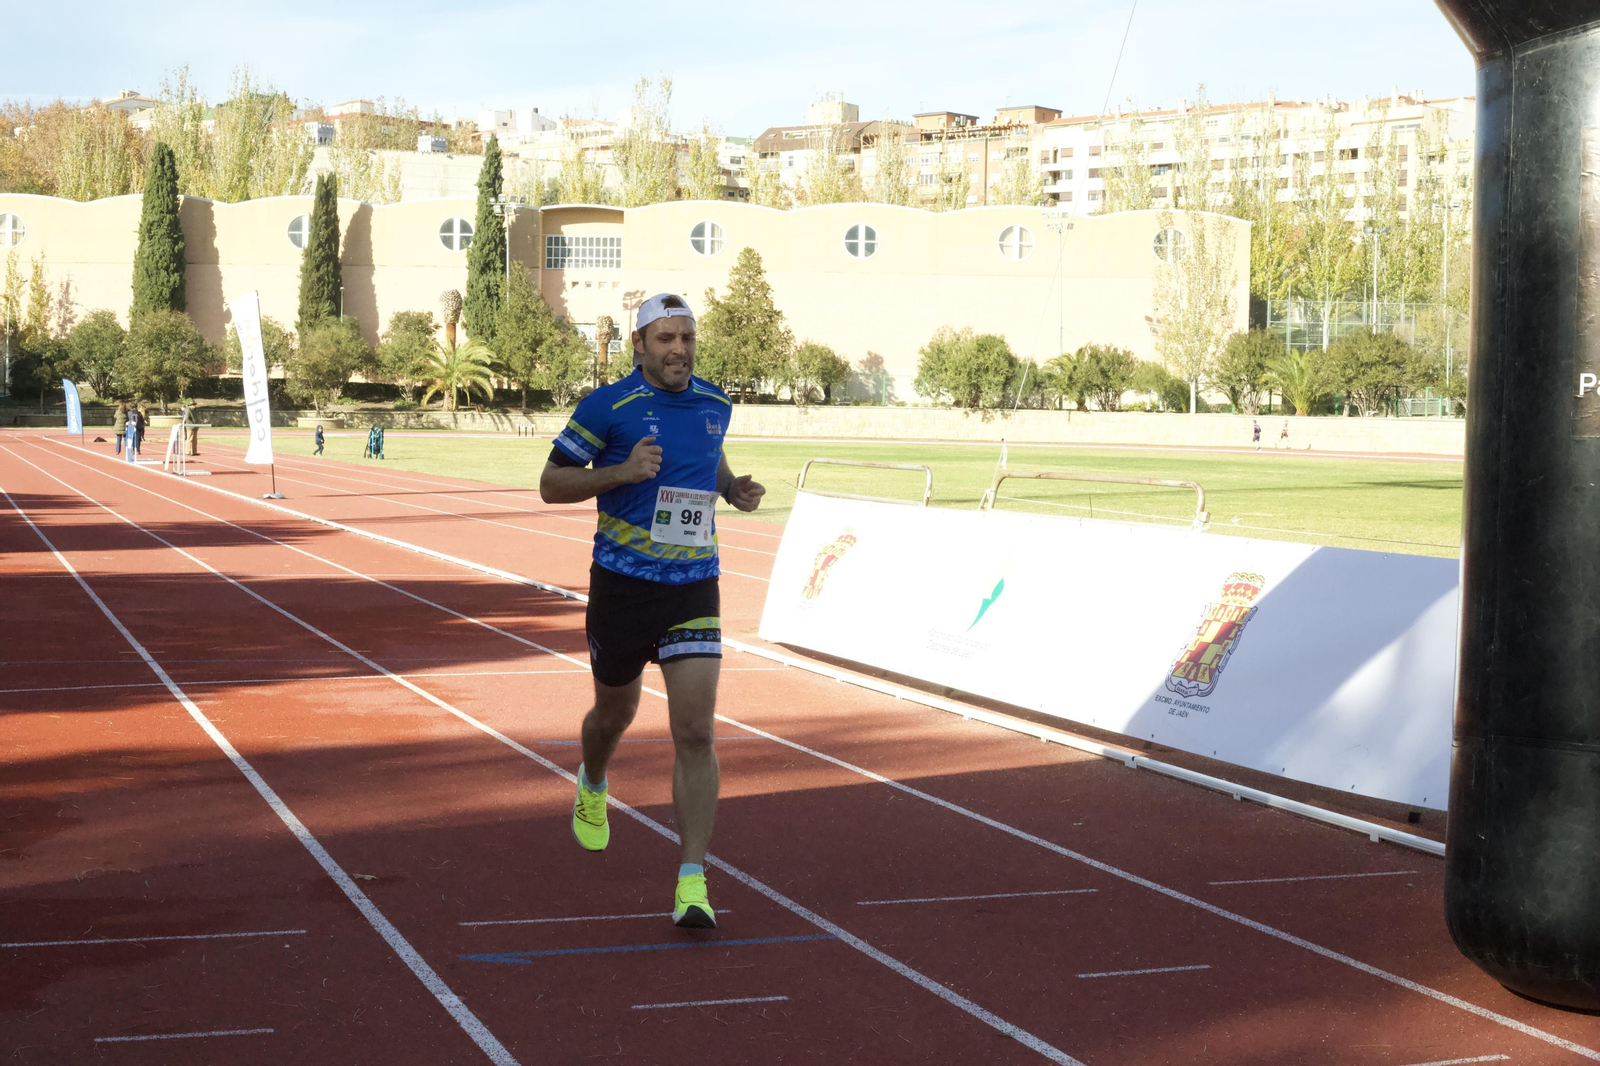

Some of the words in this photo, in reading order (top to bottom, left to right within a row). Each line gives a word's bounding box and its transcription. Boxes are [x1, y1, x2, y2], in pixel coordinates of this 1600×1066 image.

[1579, 372, 1600, 396] P
[659, 490, 676, 504] XXV
[680, 509, 702, 526] 98
[1155, 694, 1172, 705] EXCMO.
[1173, 699, 1210, 713] AYUNTAMIENTO
[1176, 709, 1189, 718] JAÉN
